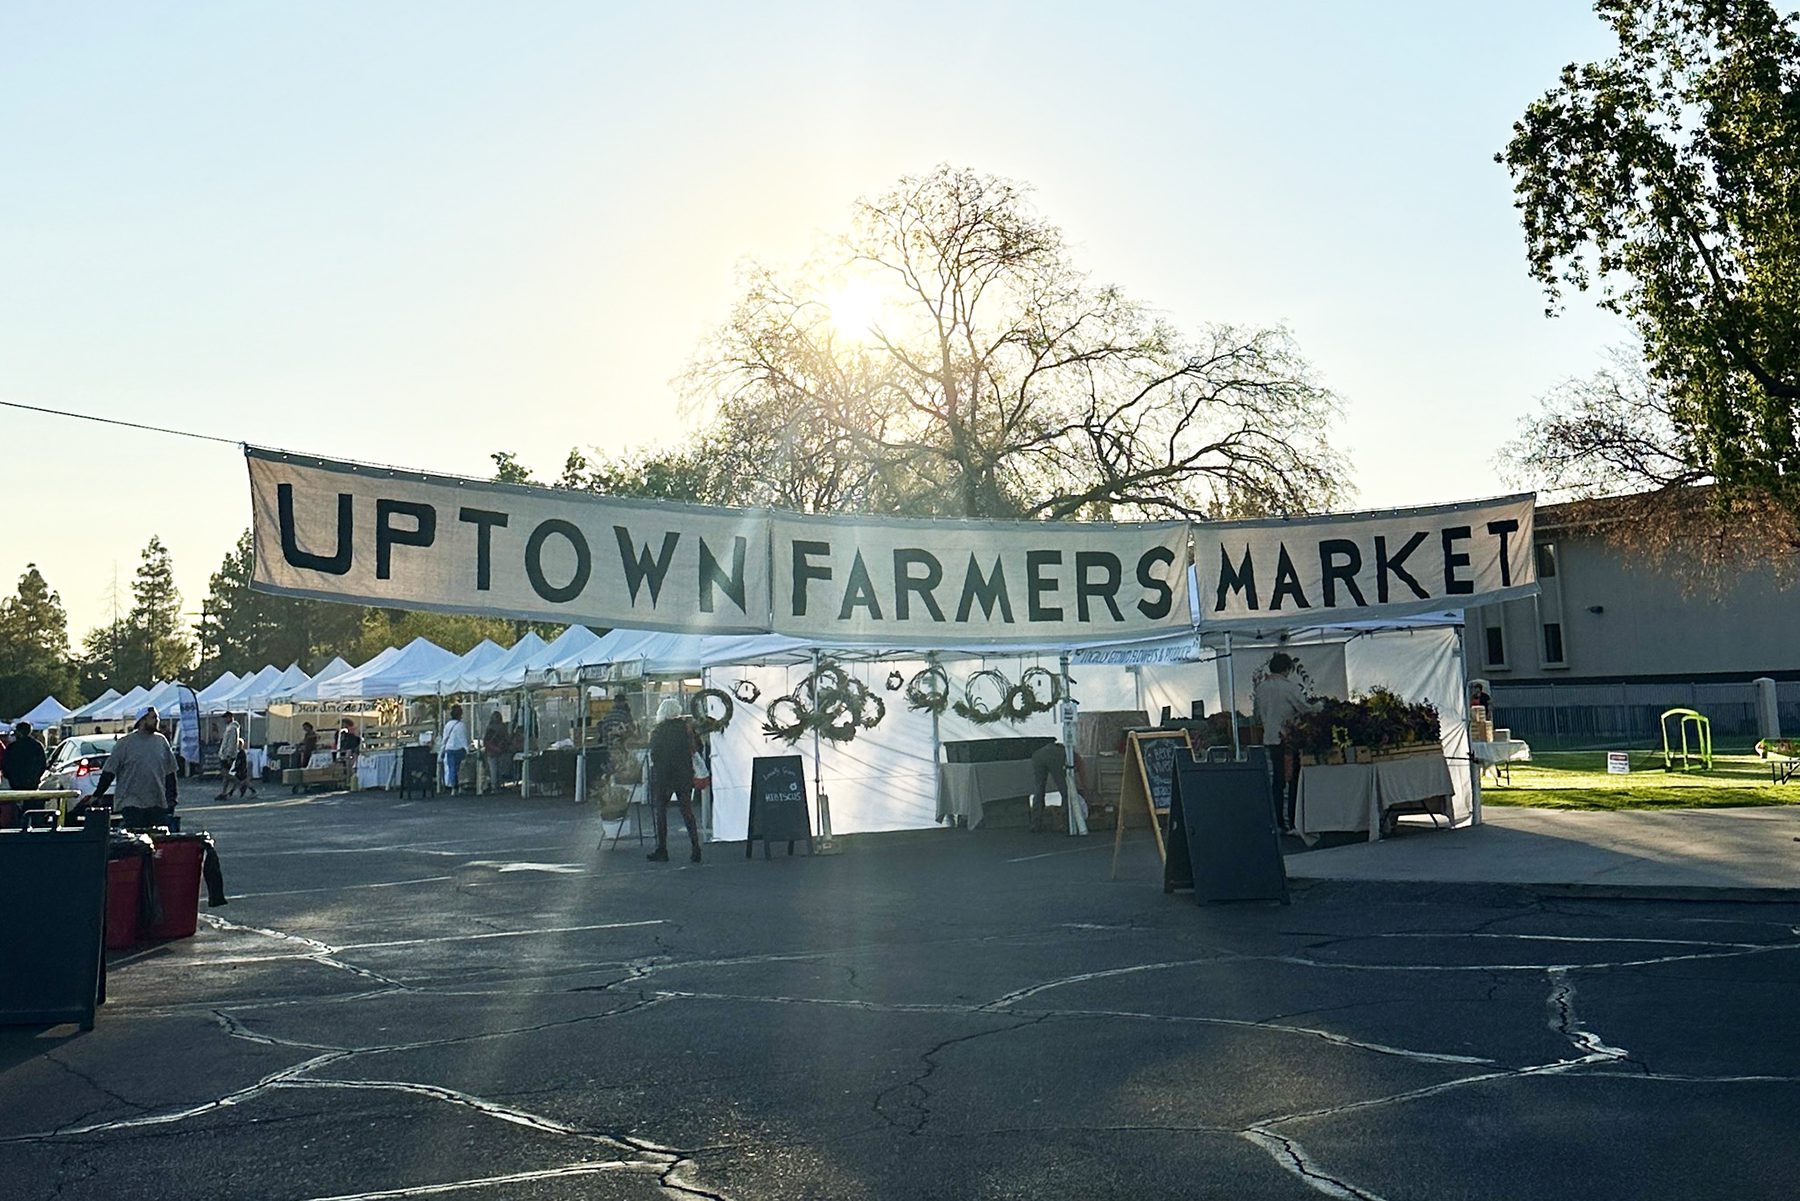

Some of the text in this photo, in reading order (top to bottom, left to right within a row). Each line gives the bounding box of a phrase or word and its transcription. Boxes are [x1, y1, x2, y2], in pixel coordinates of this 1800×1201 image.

[277, 483, 1519, 623] UPTOWN FARMERS MARKET
[765, 792, 801, 802] HIBISCUS
